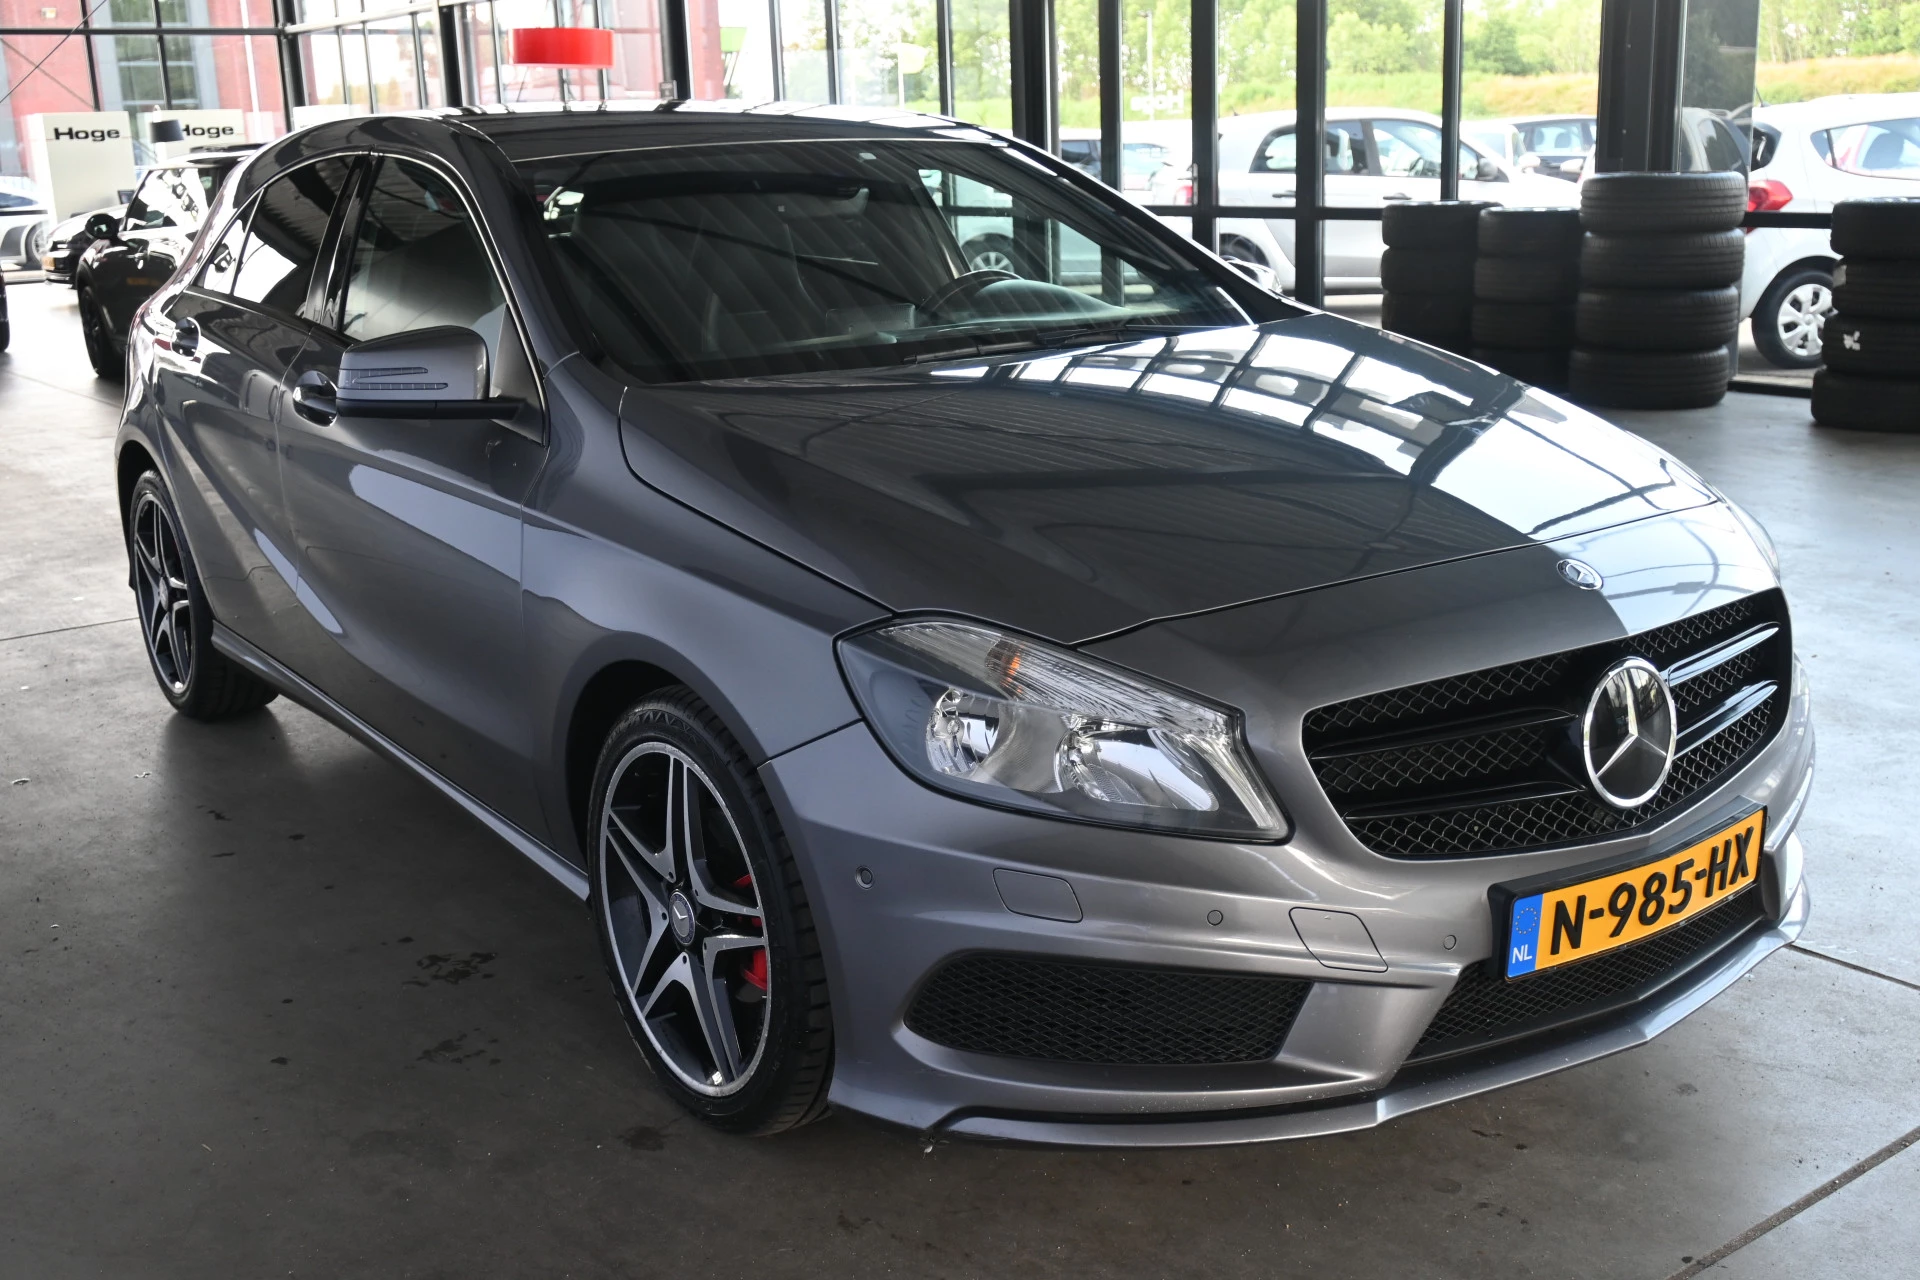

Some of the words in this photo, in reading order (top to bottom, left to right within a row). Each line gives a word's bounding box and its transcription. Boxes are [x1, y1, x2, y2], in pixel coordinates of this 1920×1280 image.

[54, 127, 120, 142] Hoge
[1550, 826, 1754, 955] N-985-HX
[1512, 944, 1533, 963] NL
